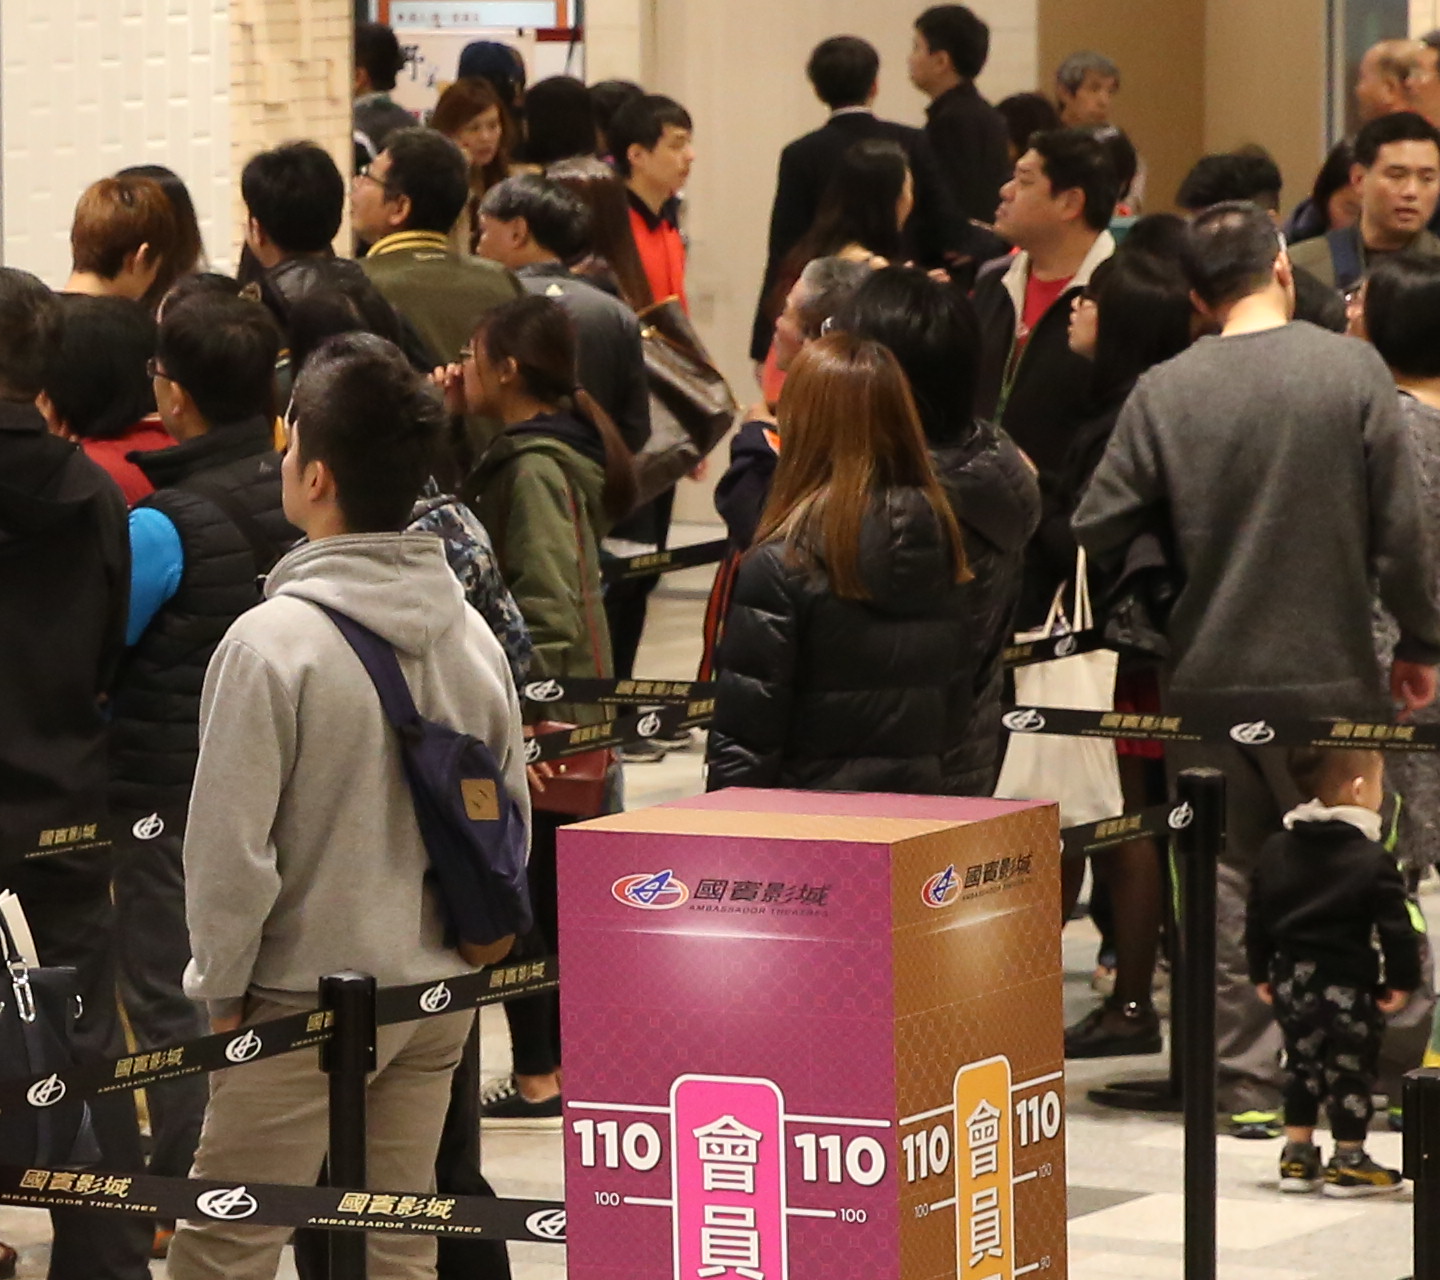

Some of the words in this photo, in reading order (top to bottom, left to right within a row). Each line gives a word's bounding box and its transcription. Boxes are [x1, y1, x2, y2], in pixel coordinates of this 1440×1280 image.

[693, 878, 831, 907] 國賓影城
[688, 904, 767, 915] AMBASSADOR
[1015, 1090, 1061, 1147] 110
[572, 1118, 662, 1172] 110
[793, 1132, 888, 1187] 110
[901, 1124, 951, 1183] 110
[19, 1168, 133, 1200] 國賓影城
[88, 1200, 159, 1214] THEATRES
[336, 1191, 457, 1220] 國賓影城
[594, 1191, 621, 1207] 100
[307, 1216, 405, 1230] AMBASSADOR
[409, 1222, 483, 1234] THEATRES
[839, 1207, 867, 1224] 100
